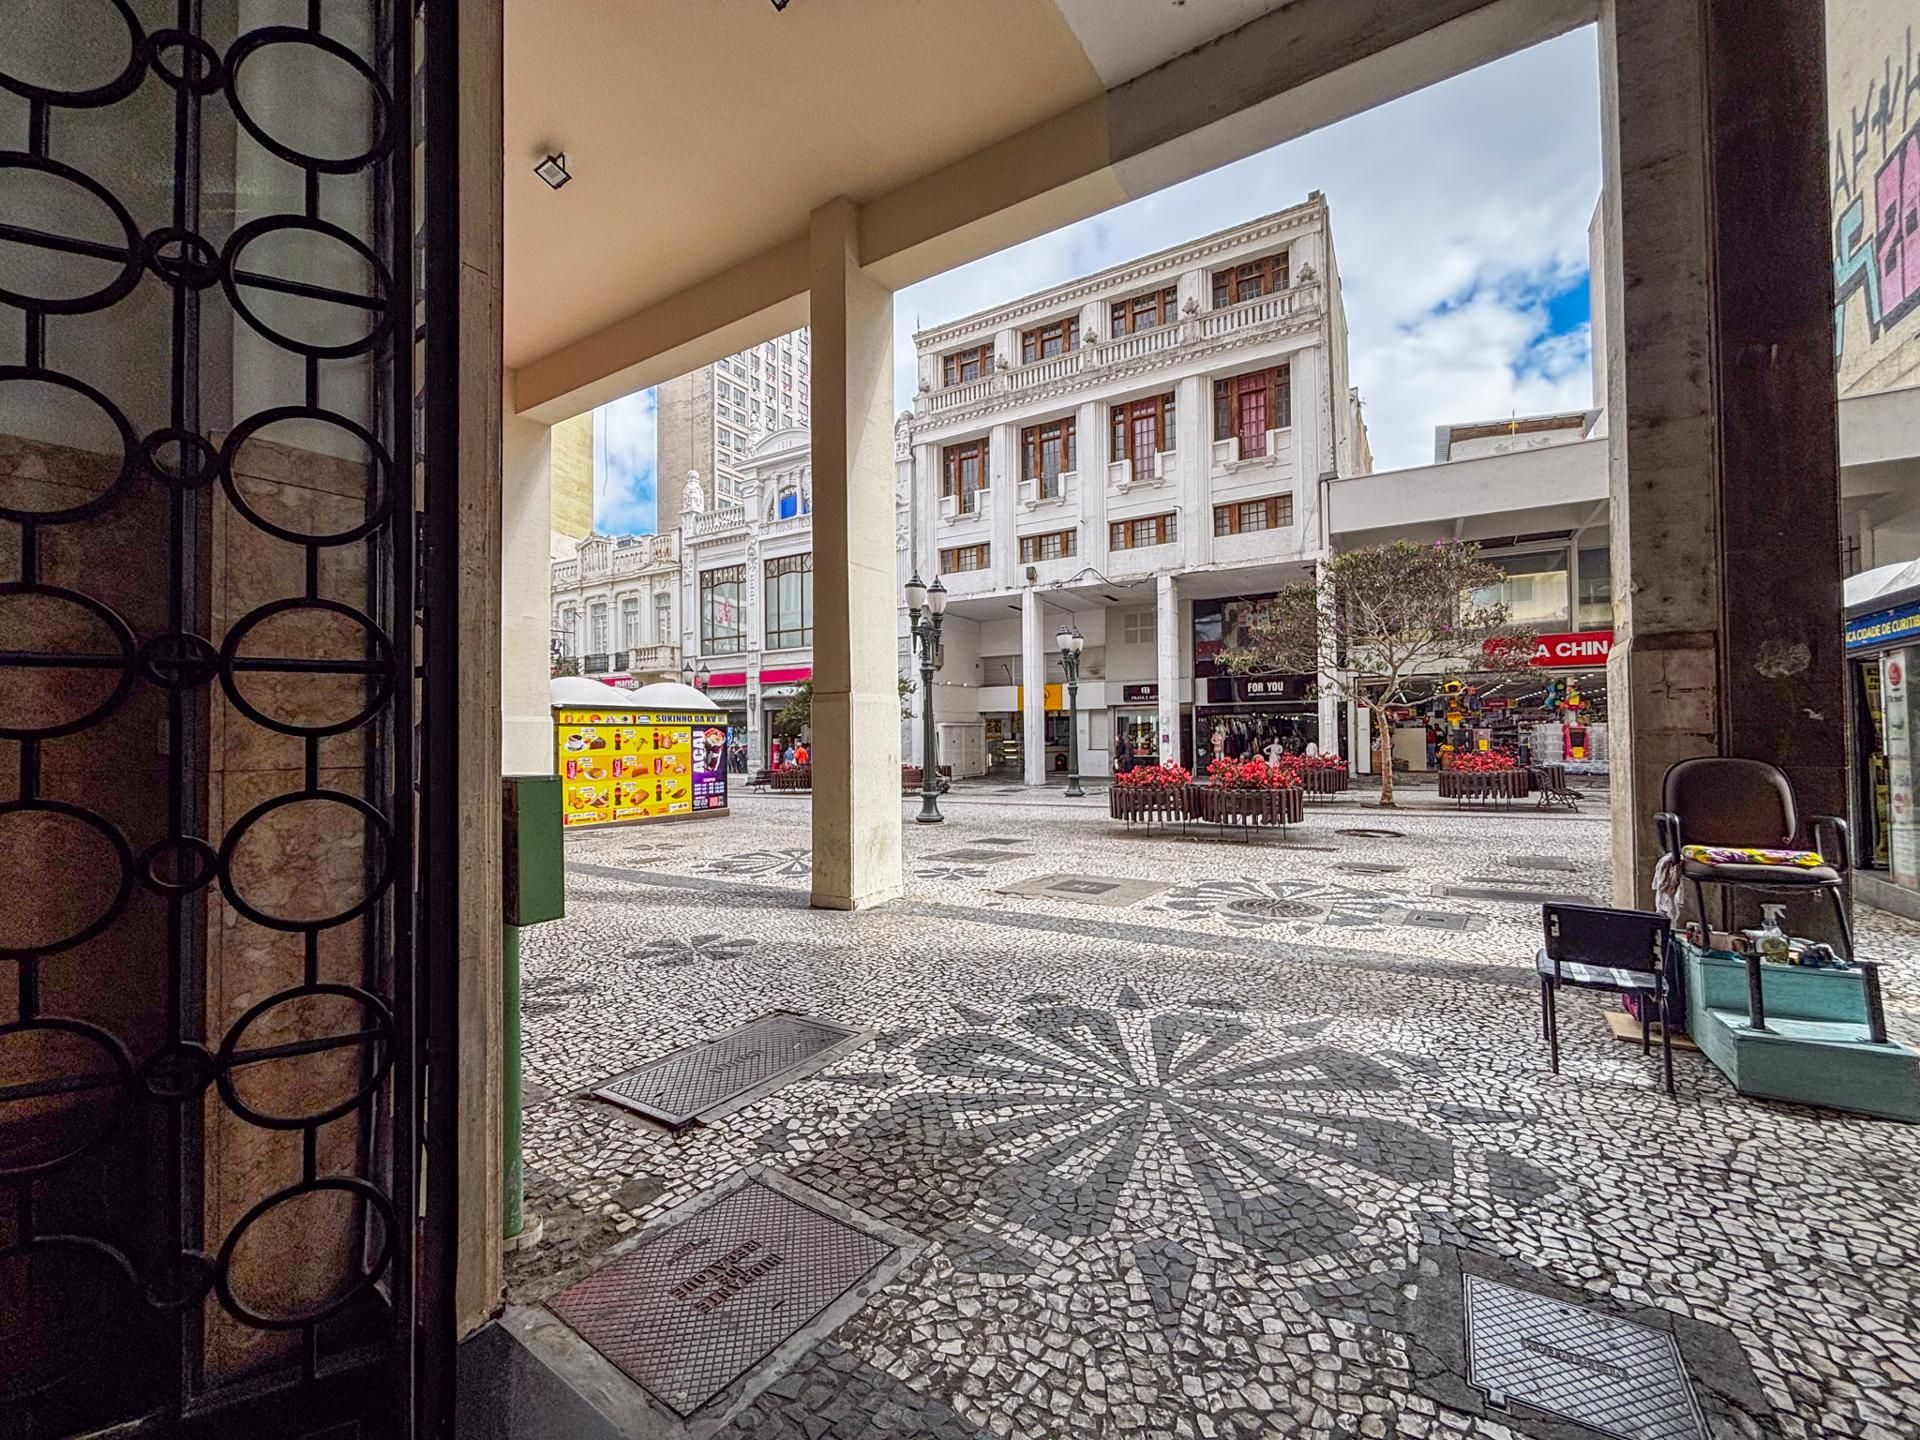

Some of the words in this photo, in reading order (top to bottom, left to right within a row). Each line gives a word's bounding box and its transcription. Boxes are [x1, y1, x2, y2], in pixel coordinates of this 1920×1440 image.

[1857, 624, 1881, 640] CIDADE
[1881, 622, 1892, 635] DE
[1892, 614, 1920, 632] CURITIB
[1555, 640, 1608, 657] CHIN
[1247, 682, 1264, 693] FOR
[1267, 681, 1284, 692] YOU
[656, 714, 693, 723] SUKINHO
[695, 715, 705, 723] DA
[694, 1253, 785, 1314] HIDRANTE
